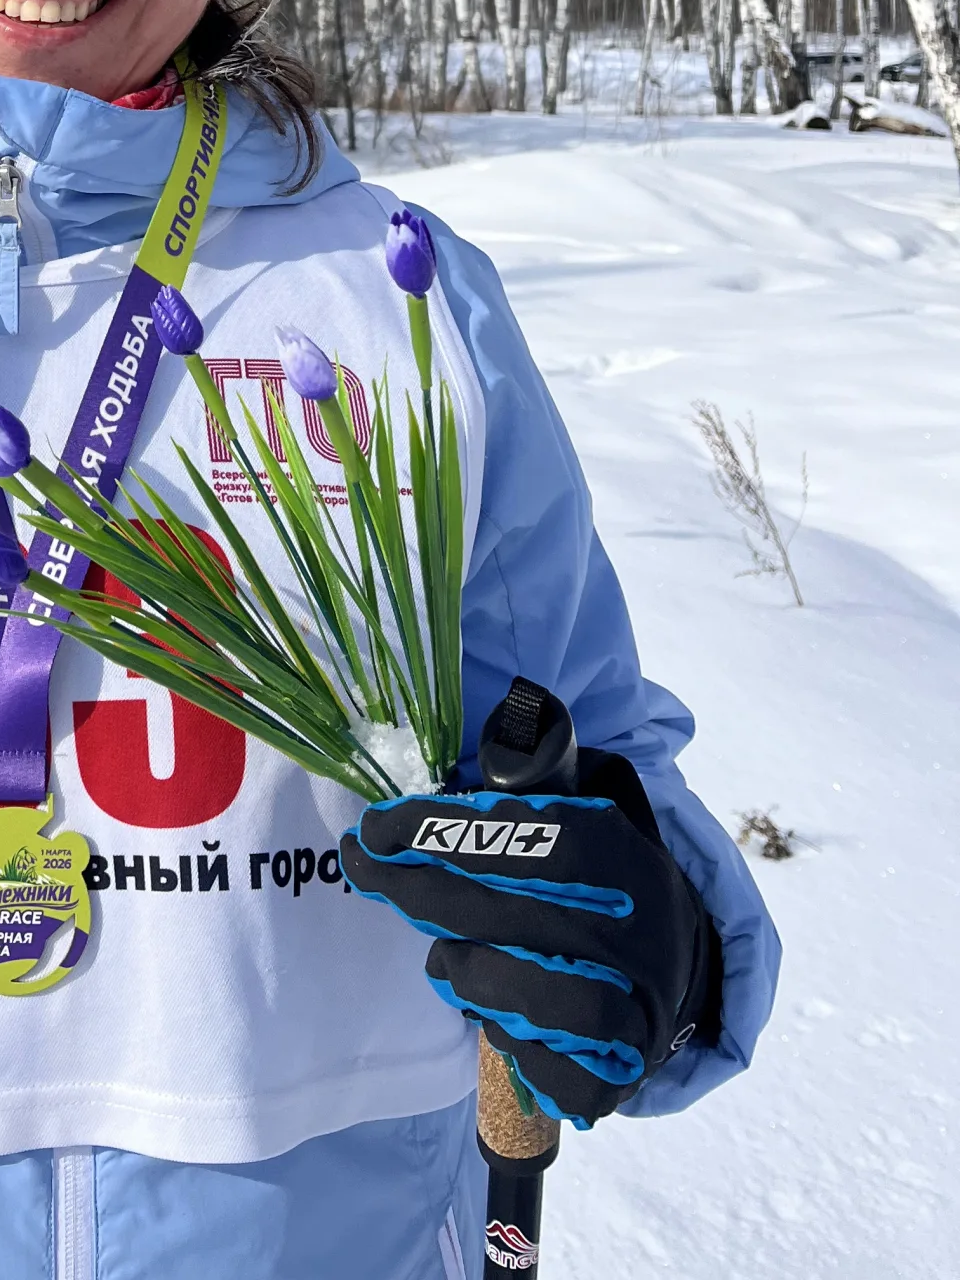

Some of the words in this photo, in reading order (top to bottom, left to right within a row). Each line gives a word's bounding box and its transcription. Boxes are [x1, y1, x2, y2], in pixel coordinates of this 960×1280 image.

[90, 313, 154, 446] ХОДЬБА
[43, 858, 72, 869] 2026
[249, 847, 352, 897] горо
[0, 910, 43, 925] RACE
